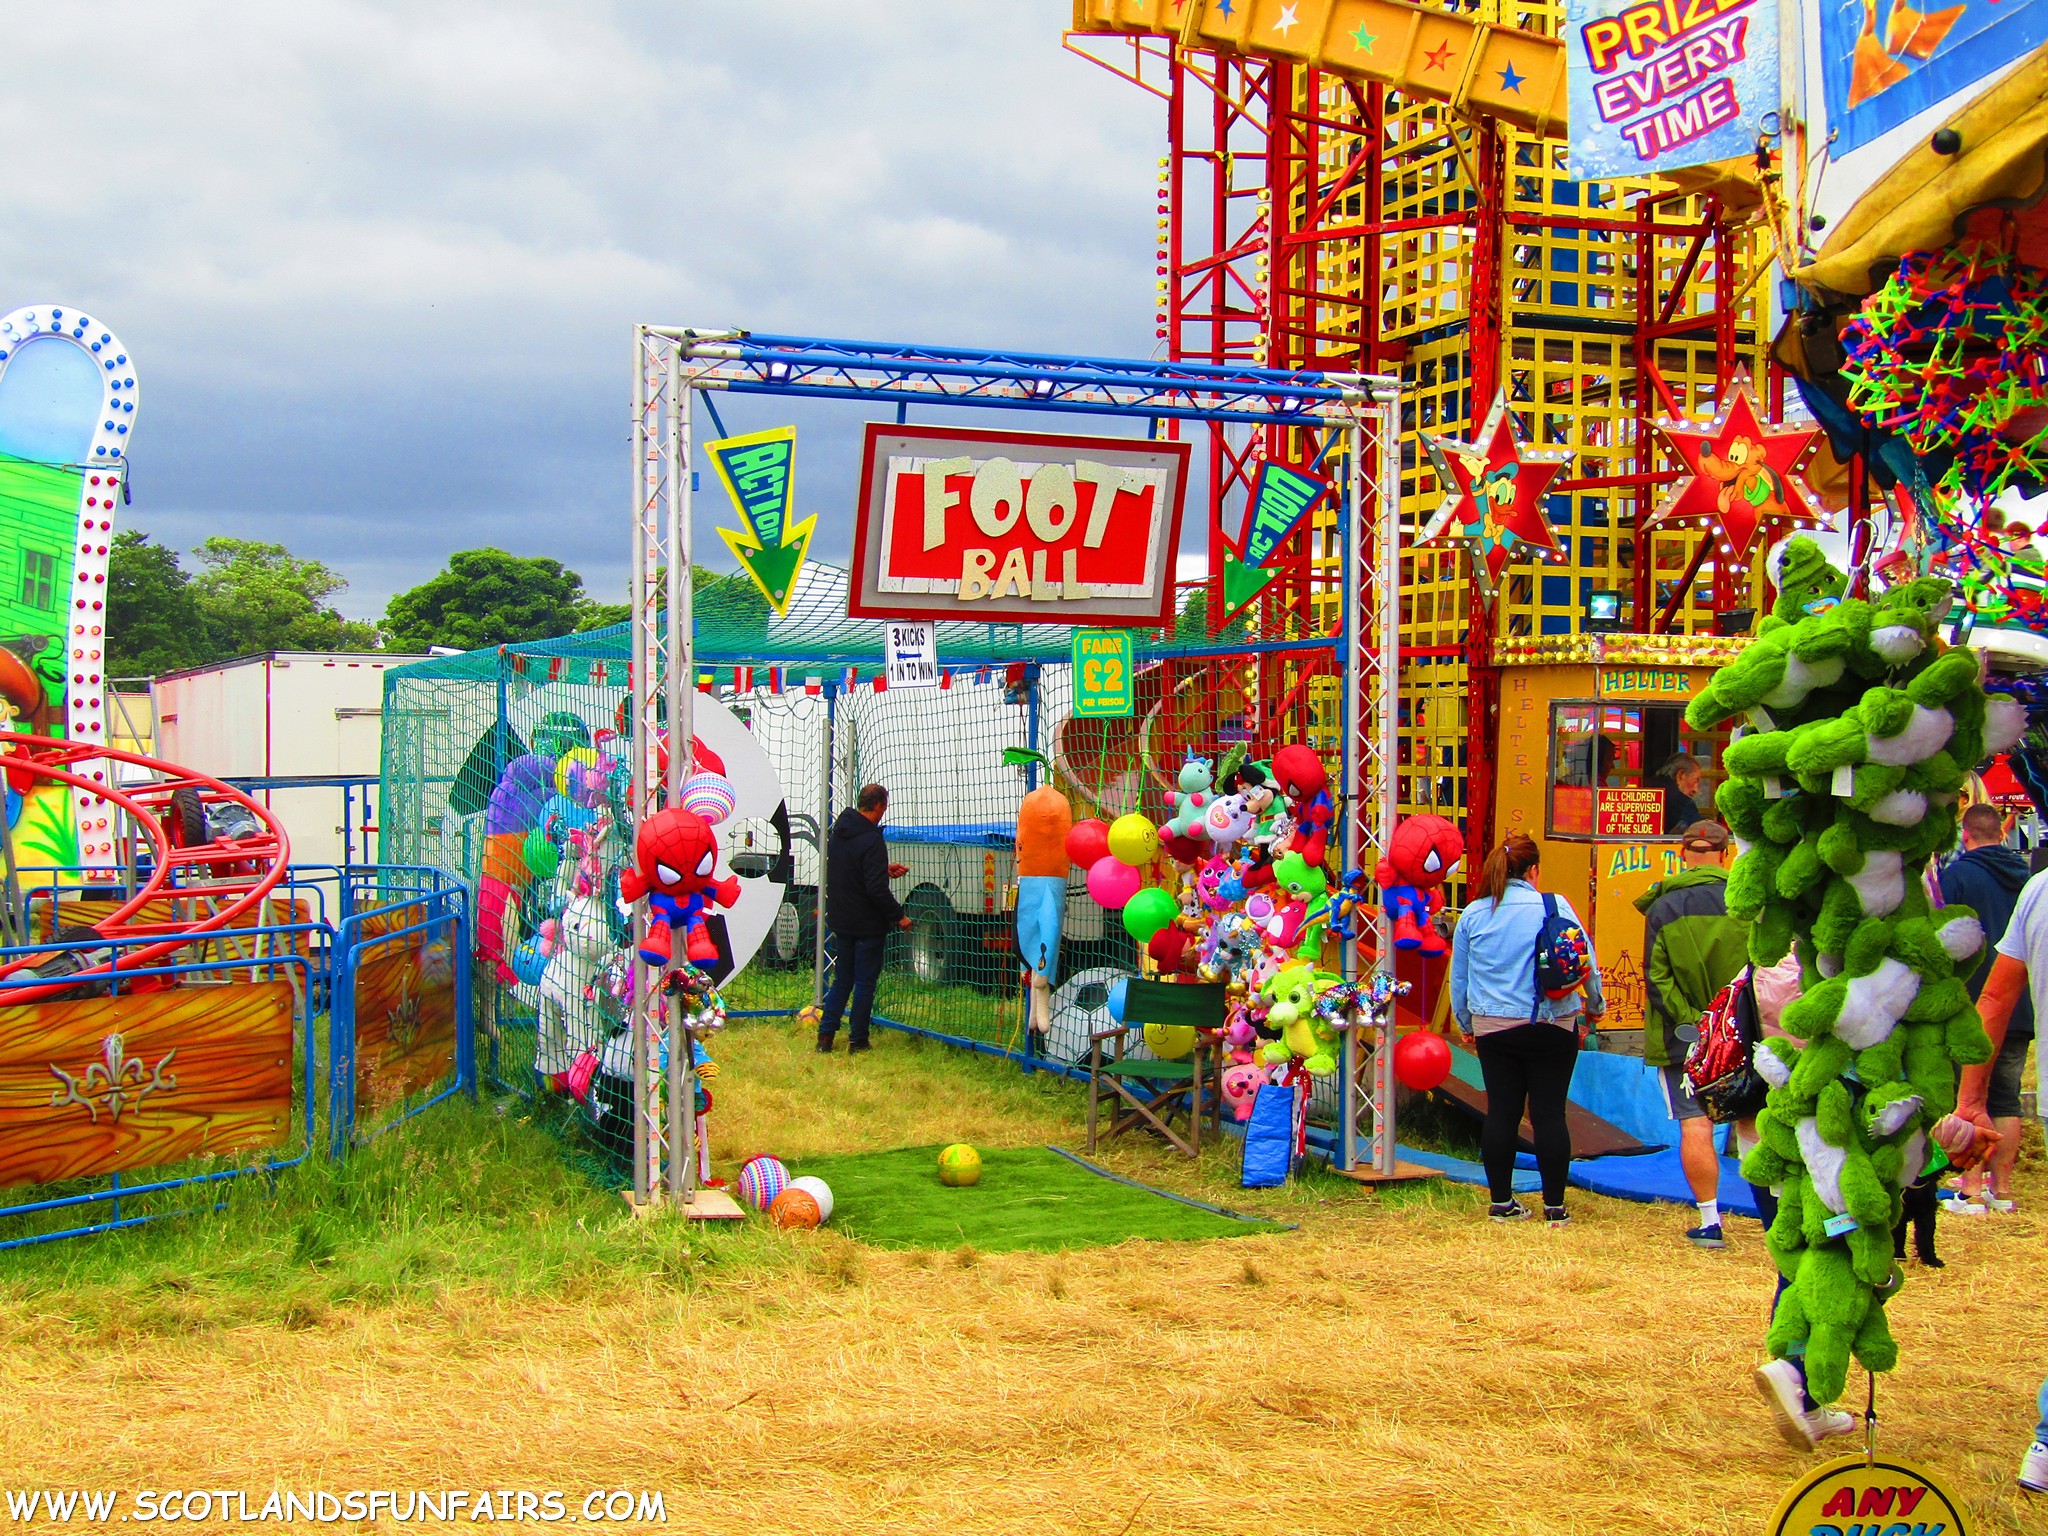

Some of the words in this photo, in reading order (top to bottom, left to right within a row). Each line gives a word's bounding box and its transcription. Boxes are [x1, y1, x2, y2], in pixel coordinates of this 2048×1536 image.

[1595, 18, 1746, 121] EVERY
[1622, 80, 1737, 159] TIME
[923, 455, 1145, 552] FOOT
[957, 547, 1091, 601] BALL
[892, 627, 901, 647] 3
[902, 627, 925, 646] KICKS
[1082, 638, 1122, 654] FARE
[896, 663, 905, 681] IN
[906, 662, 917, 681] TO
[918, 661, 933, 680] WIN
[1083, 658, 1123, 692] £2
[1603, 669, 1691, 694] HELTER
[1082, 698, 1096, 707] PER
[1097, 697, 1125, 706] PERSON
[1510, 678, 1533, 786] HELTER
[1600, 802, 1615, 812] ARE
[1616, 802, 1661, 813] SUPERVISED
[1606, 791, 1620, 802] ALL
[1621, 791, 1656, 802] CHILDREN
[1605, 823, 1616, 833] OF
[1617, 823, 1631, 833] THE
[1632, 824, 1653, 834] SLIDE
[1610, 813, 1619, 823] AT
[1620, 813, 1634, 823] THE
[1636, 813, 1650, 823] TOP
[1607, 846, 1652, 878] ALL
[1822, 1487, 1927, 1518] ANY
